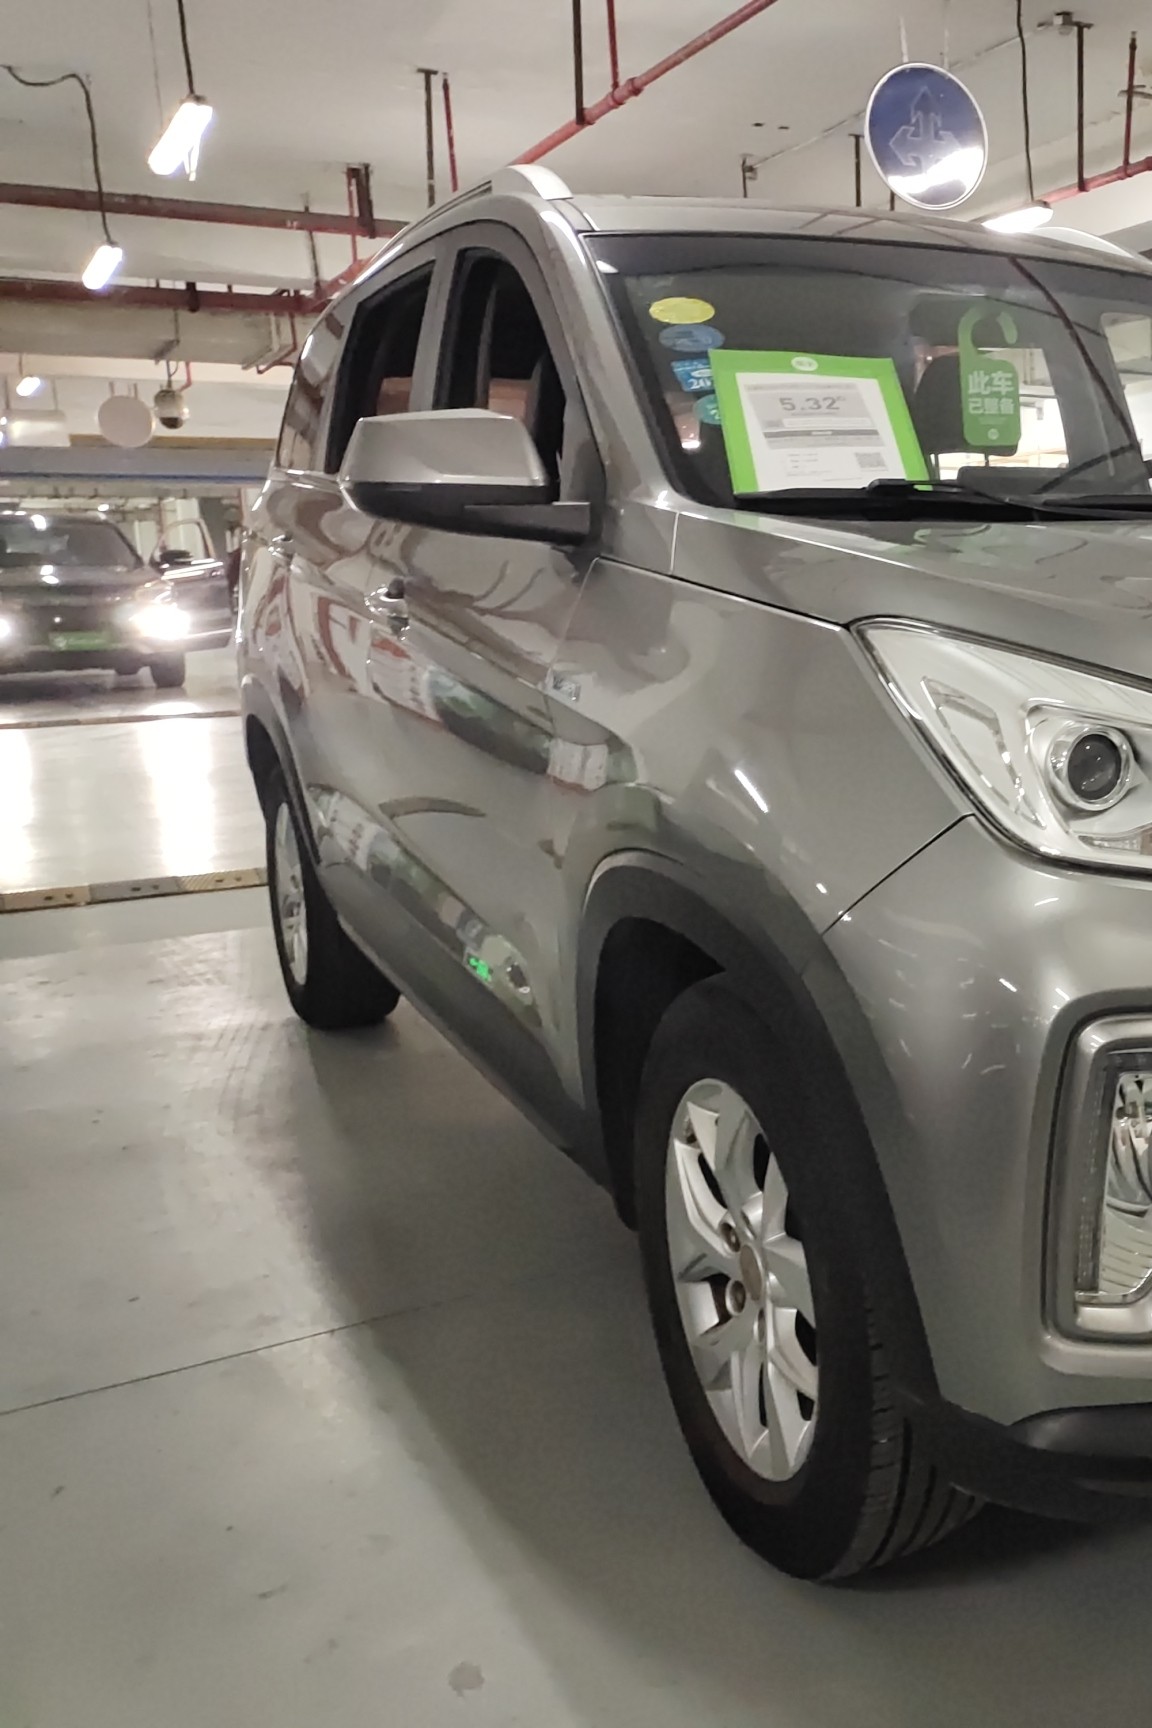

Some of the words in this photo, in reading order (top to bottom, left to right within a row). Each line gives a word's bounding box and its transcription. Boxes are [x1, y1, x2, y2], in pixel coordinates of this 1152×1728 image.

[968, 371, 1014, 395] 此车
[968, 397, 1014, 415] 已整备
